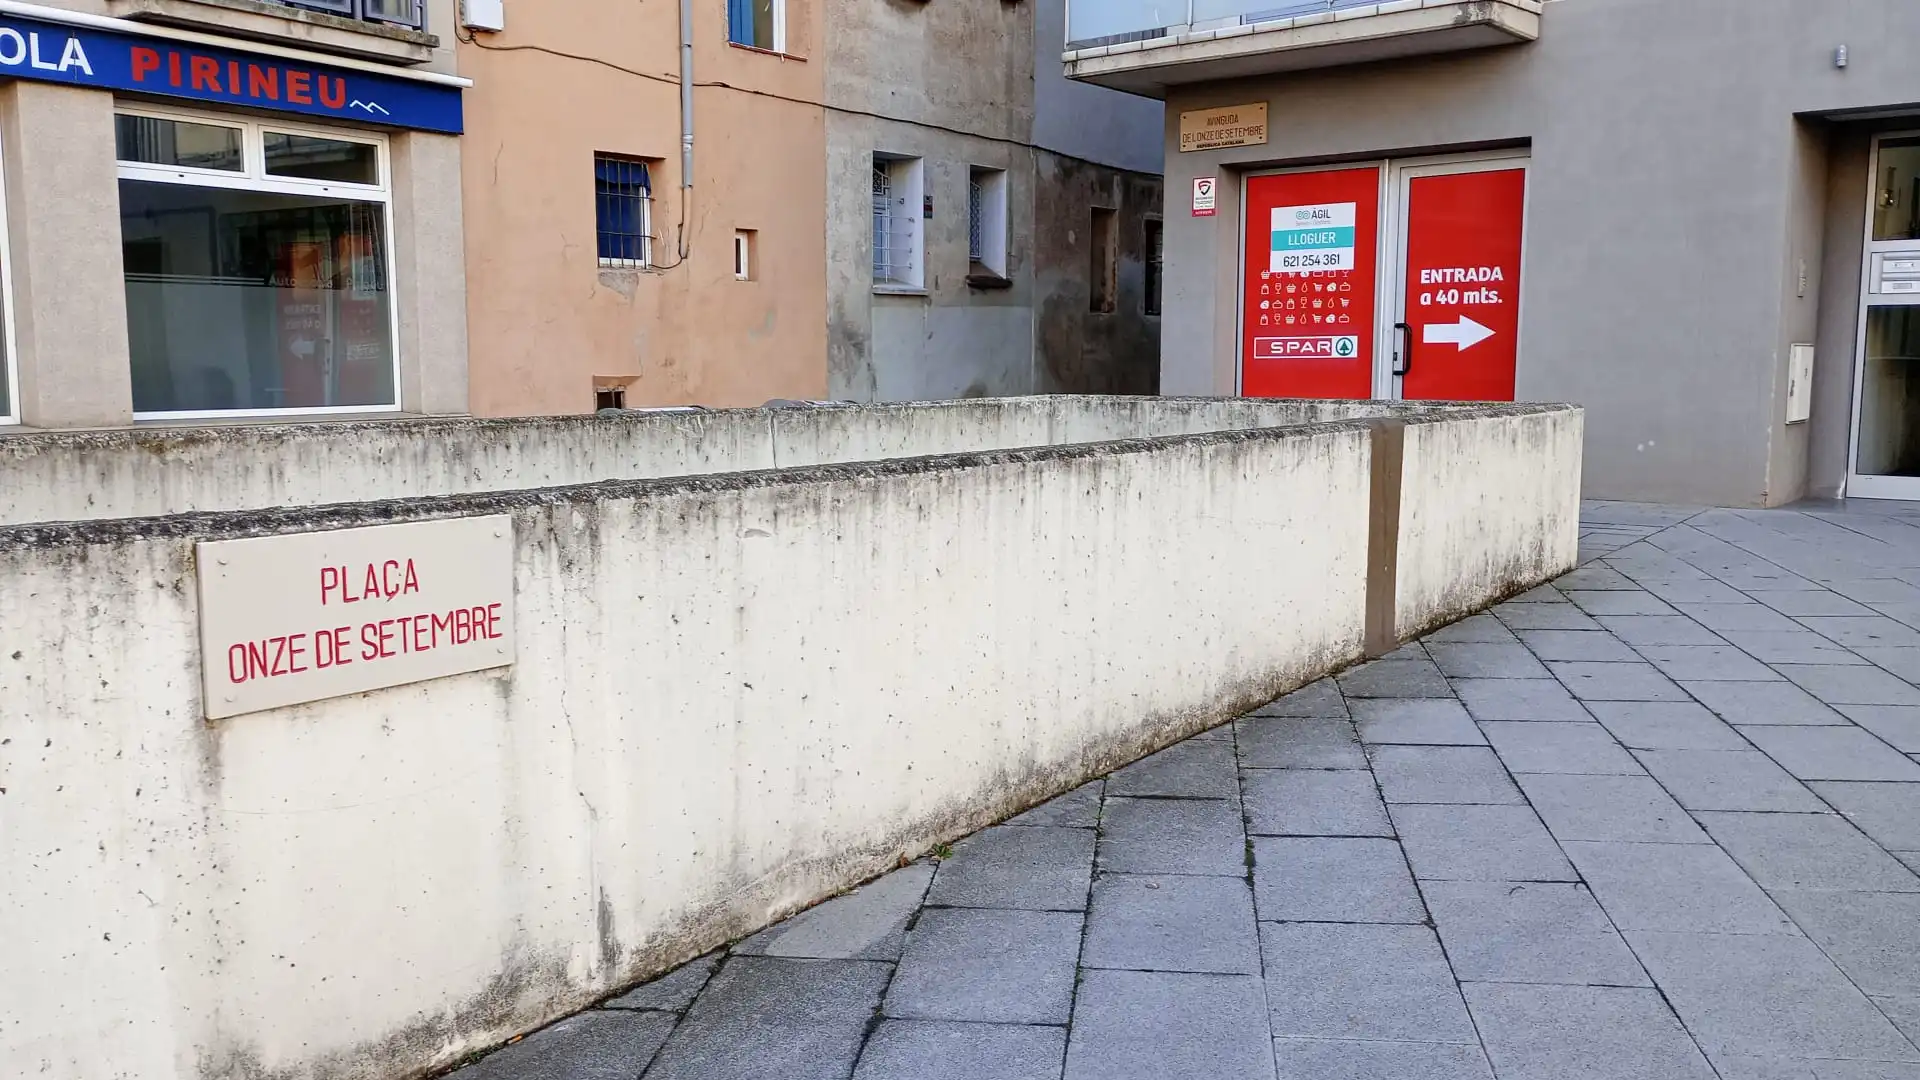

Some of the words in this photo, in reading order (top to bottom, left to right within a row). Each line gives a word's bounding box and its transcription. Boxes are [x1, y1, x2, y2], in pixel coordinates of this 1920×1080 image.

[0, 27, 94, 75] OLA
[131, 46, 347, 109] PIRINEU
[1206, 114, 1239, 126] AVINGUDA
[1225, 125, 1264, 139] SETEMBRE
[1288, 231, 1336, 246] LLOGUER
[1283, 255, 1300, 268] 621
[1302, 254, 1320, 267] 254
[1323, 253, 1340, 266] 361
[1420, 266, 1504, 284] ENTRADA
[1420, 292, 1432, 306] a
[1435, 288, 1459, 305] 40
[1463, 286, 1503, 305] mts.
[1270, 340, 1331, 354] SPAR
[320, 558, 419, 605] PLAÇA
[228, 633, 308, 684] ONZE
[315, 626, 353, 669] DE
[360, 603, 503, 662] SETEMBRE
